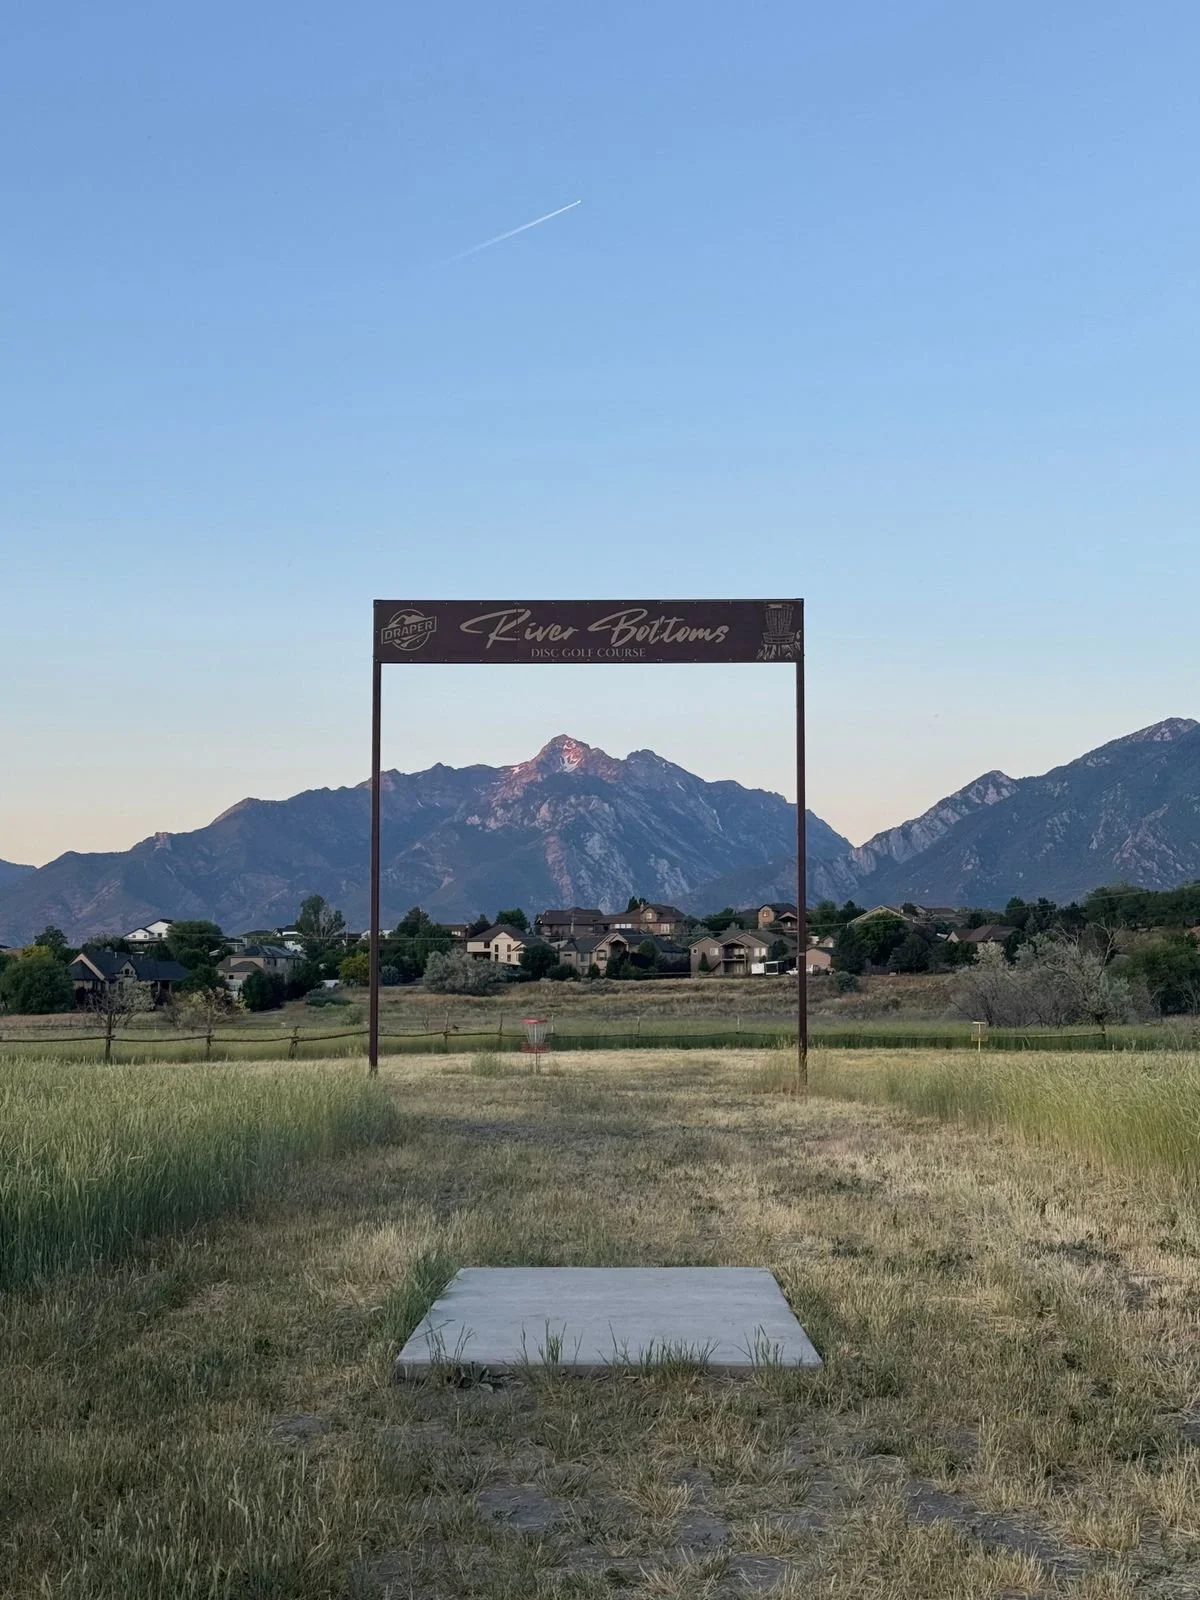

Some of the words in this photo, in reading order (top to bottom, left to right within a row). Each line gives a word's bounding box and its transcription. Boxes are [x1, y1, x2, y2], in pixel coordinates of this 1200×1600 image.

[384, 620, 433, 640] DRAPER
[459, 608, 580, 649] River
[587, 608, 730, 647] Bottoms
[531, 648, 559, 658] DISC
[562, 648, 594, 658] GOLF
[596, 647, 646, 658] COURSE
